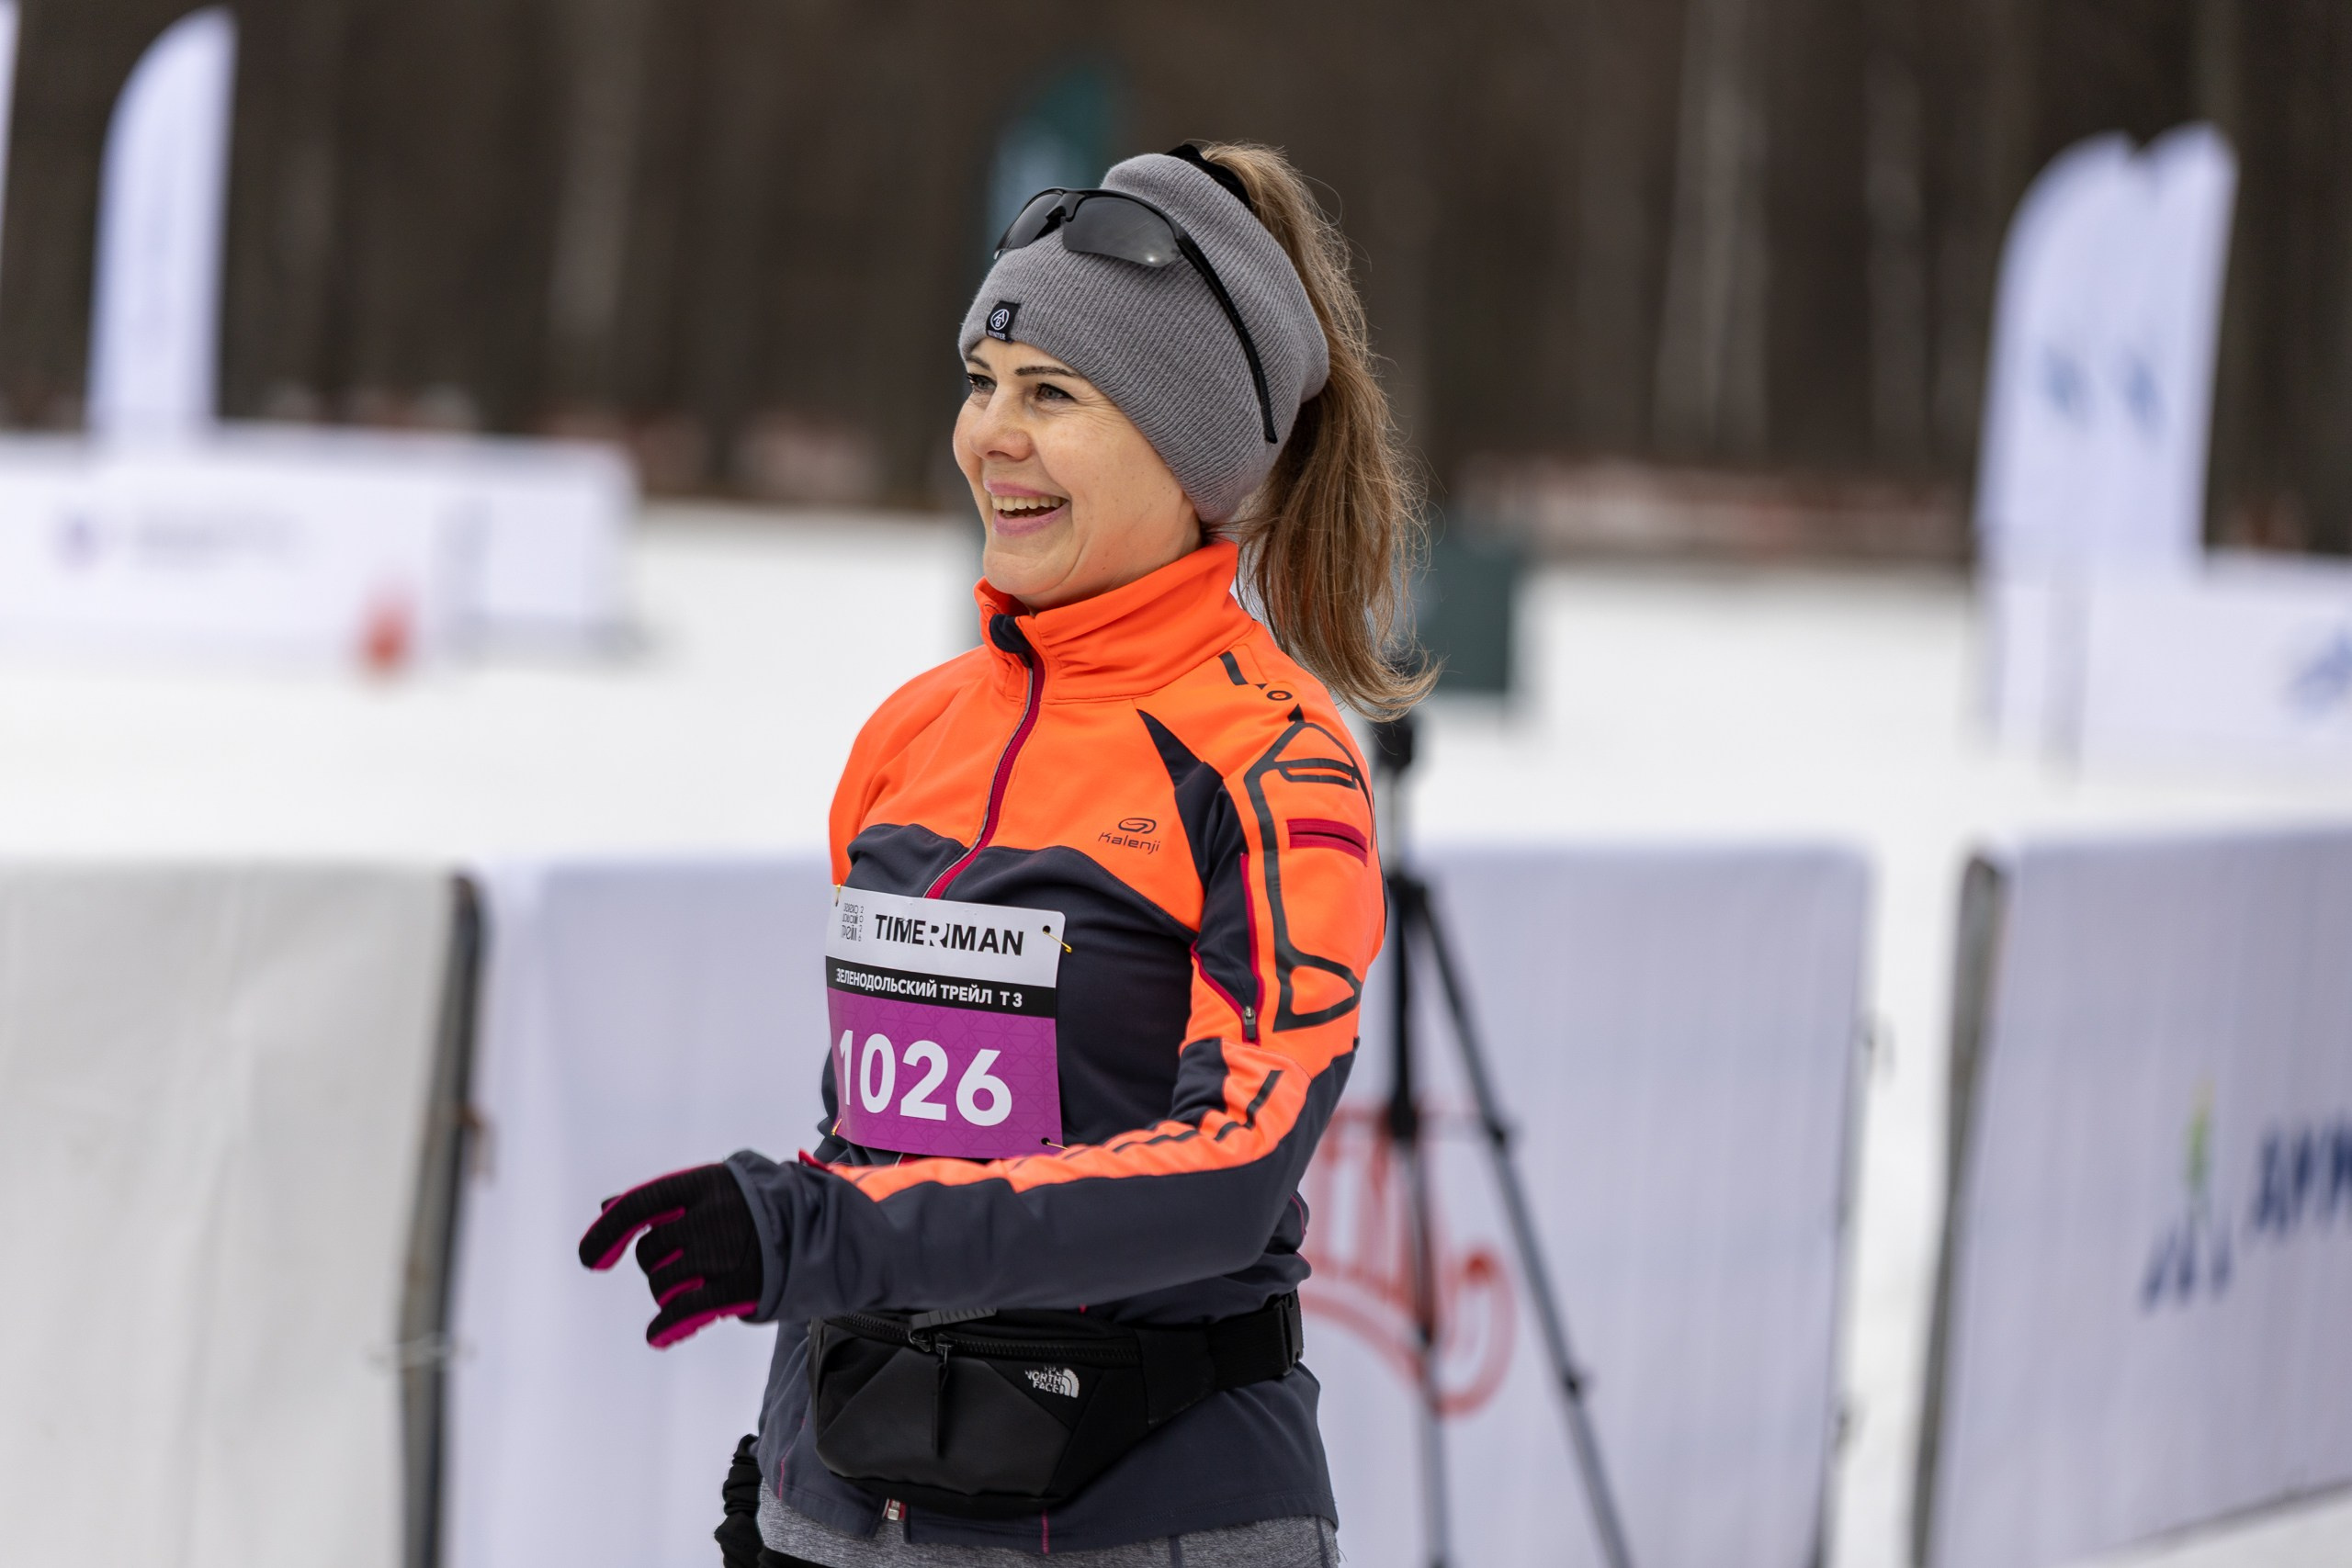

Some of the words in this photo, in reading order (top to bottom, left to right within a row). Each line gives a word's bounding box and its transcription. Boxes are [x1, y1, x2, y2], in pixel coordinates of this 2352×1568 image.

[1098, 831, 1160, 854] Kalenji
[835, 967, 937, 998] ЗЕЛЕНОДОЛЬСКИЙ
[940, 984, 993, 1005] ТРЕЙЛ
[839, 1029, 1012, 1127] 1026
[1032, 1381, 1059, 1393] FACE
